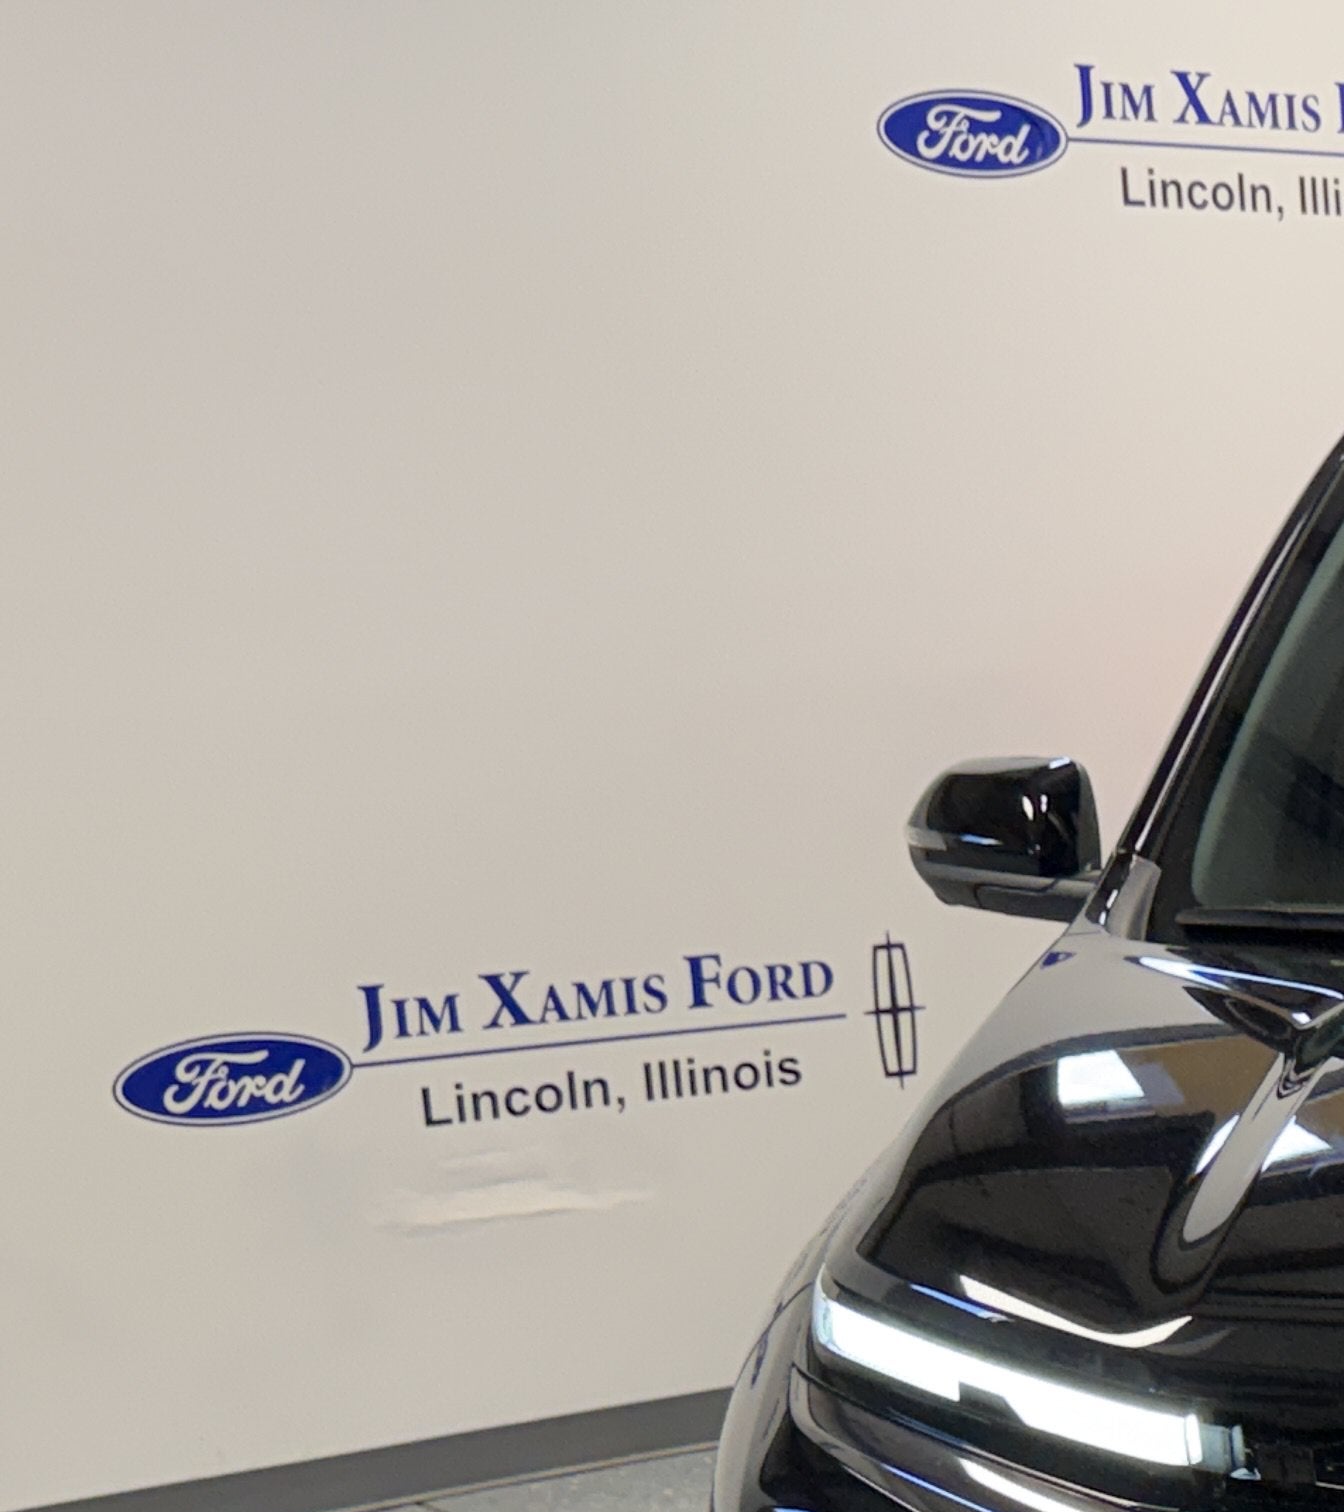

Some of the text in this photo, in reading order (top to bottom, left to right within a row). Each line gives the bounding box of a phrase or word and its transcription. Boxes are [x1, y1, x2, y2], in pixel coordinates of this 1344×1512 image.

[1074, 63, 1155, 128] JIM
[1170, 70, 1321, 133] XAMIS
[917, 104, 1029, 166] Ford
[1121, 167, 1285, 221] Lincoln,
[357, 953, 835, 1053] JIM XAMIS FORD
[163, 1050, 304, 1115] Ford
[421, 1049, 802, 1127] Lincoln, Illinois
